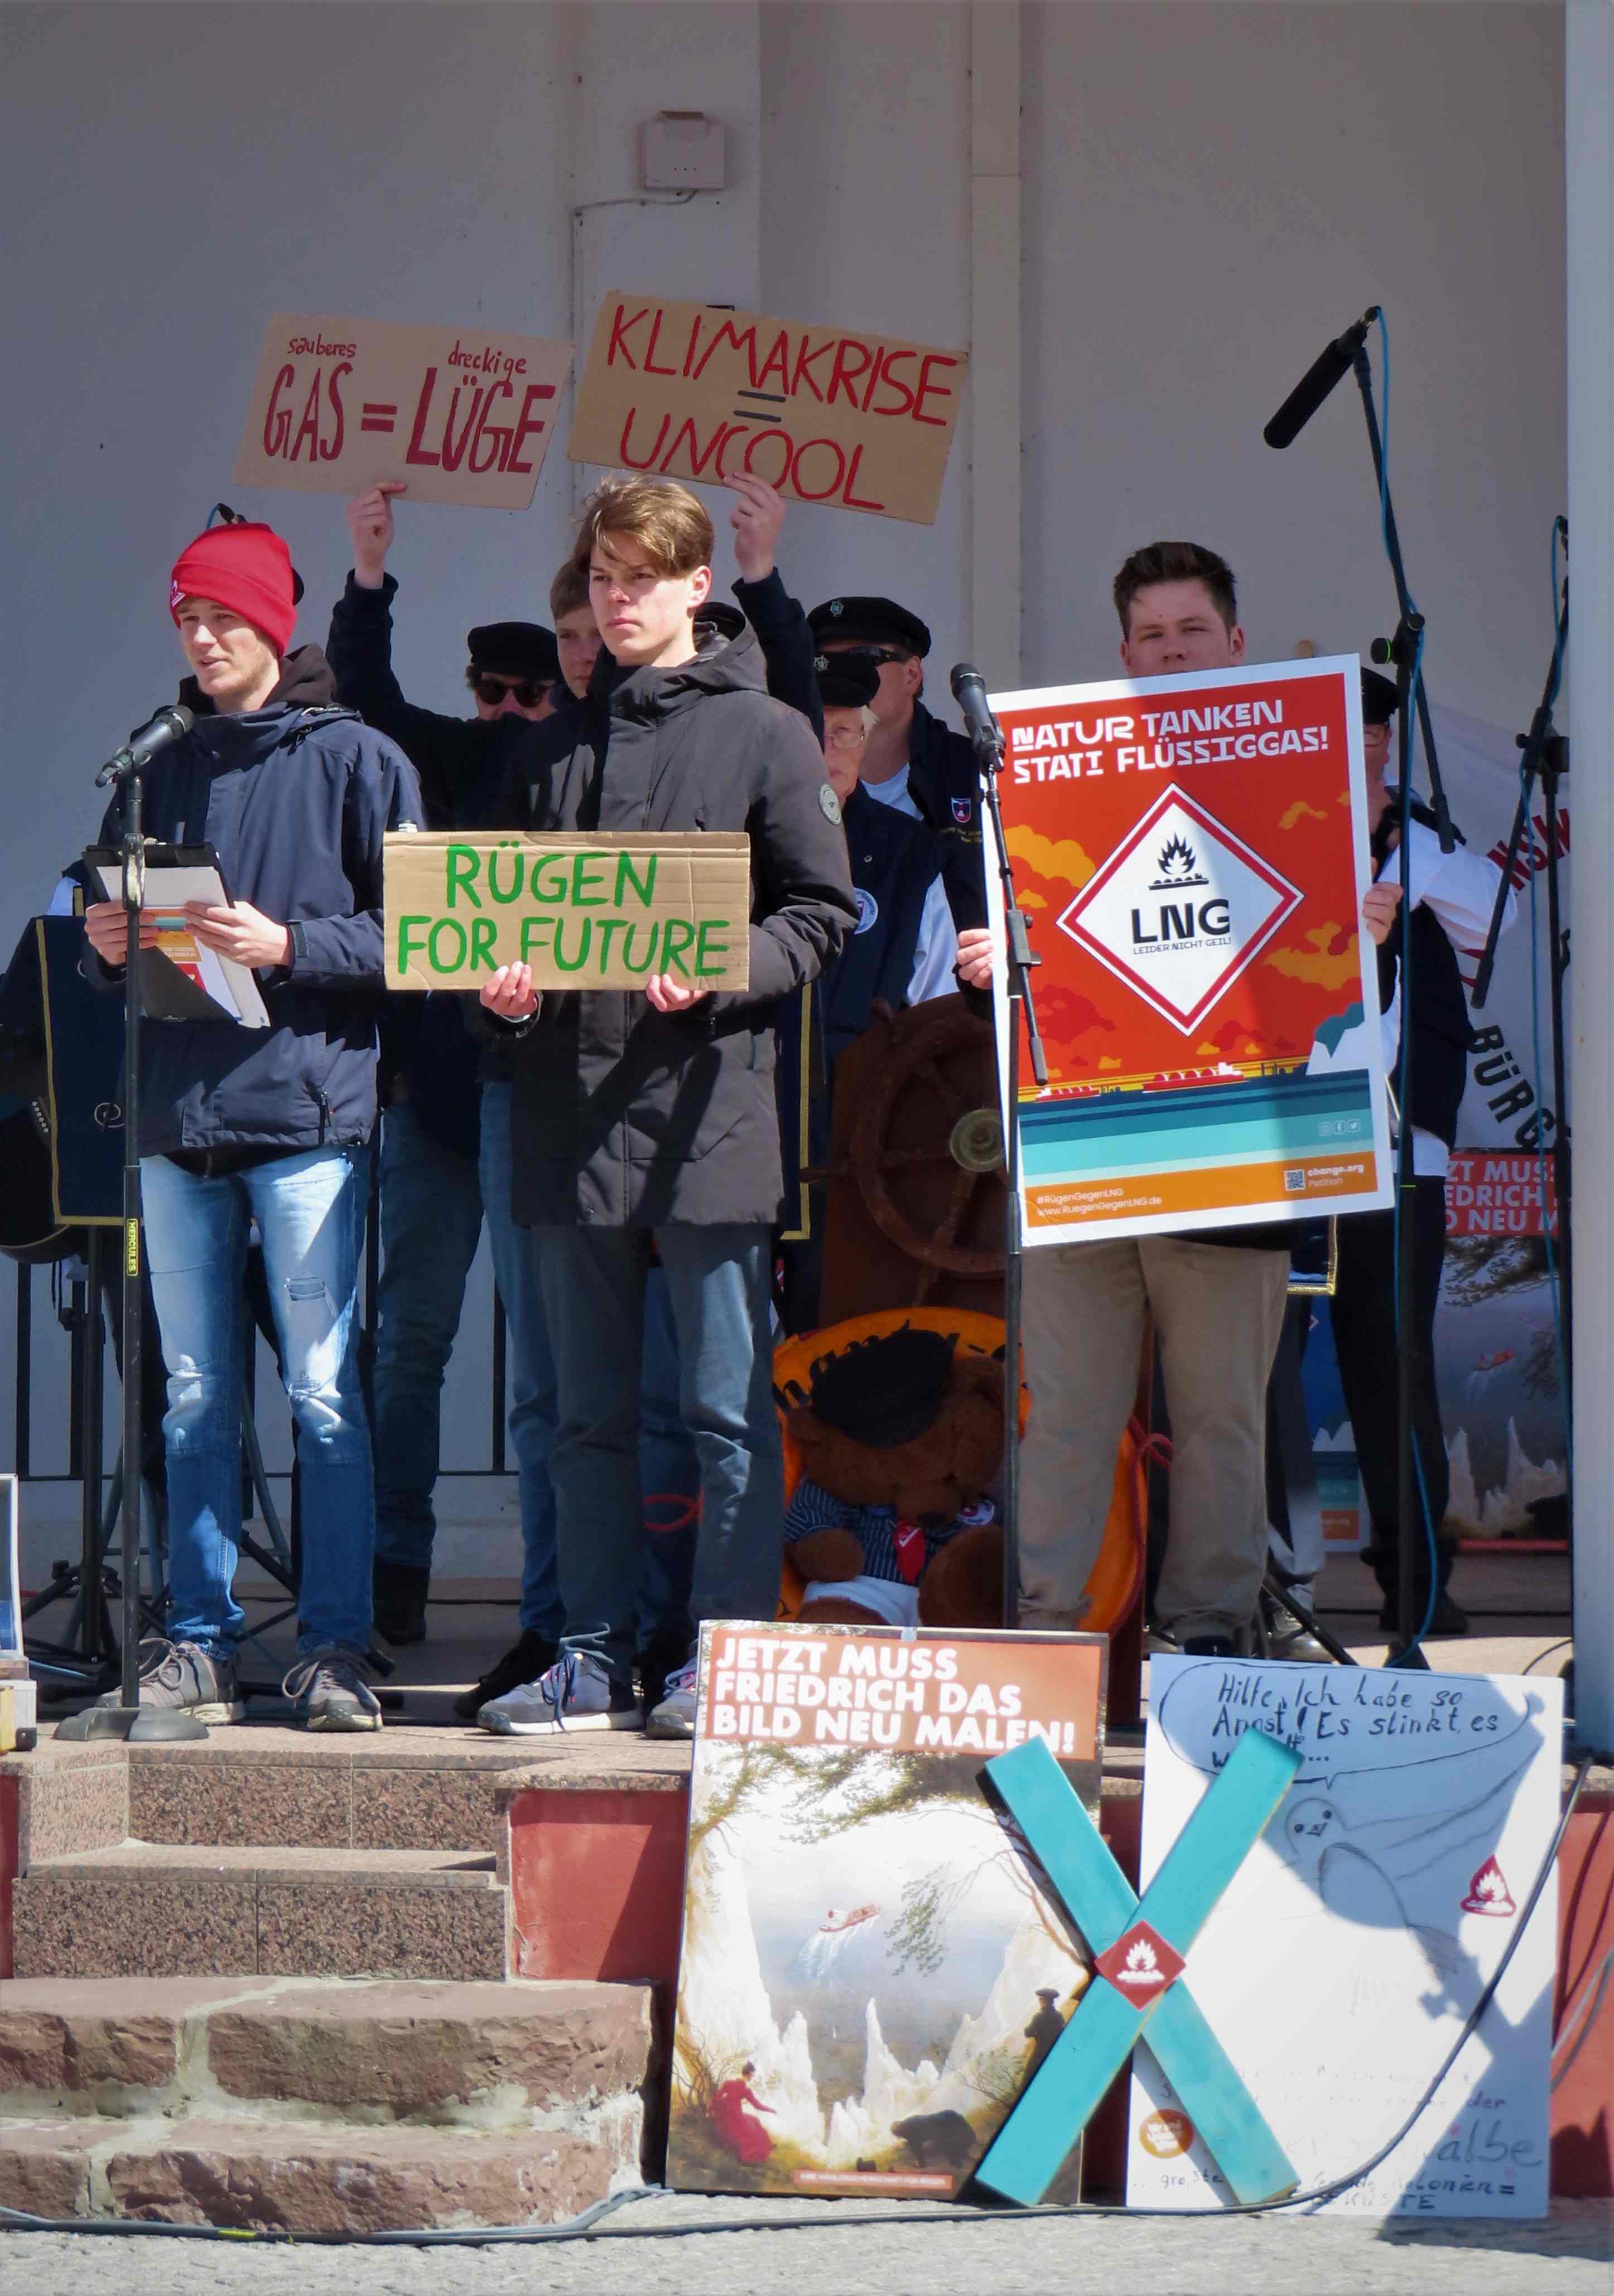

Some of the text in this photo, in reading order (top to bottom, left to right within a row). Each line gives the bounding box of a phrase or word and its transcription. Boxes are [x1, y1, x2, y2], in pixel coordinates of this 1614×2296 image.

[287, 334, 357, 358] sauberes
[447, 339, 527, 381] dreckige
[608, 304, 957, 426] KLIMAKRISE
[263, 363, 354, 462] GAS
[406, 366, 556, 474] LÜGE
[620, 407, 885, 511] UNCOOL
[1011, 698, 1283, 753] NATUR TANKEN
[1117, 726, 1328, 773] FLÜSSIGGAS!
[445, 840, 658, 908] RÜGEN
[1130, 898, 1231, 944] LNG
[397, 915, 730, 978] FOR FUTURE
[1133, 937, 1232, 955] LEIDER NICHT GEIL!
[1307, 1164, 1365, 1177] change.org
[1036, 1188, 1124, 1205] #RügenGegenLNG
[1037, 1196, 1163, 1217] www.RuegenGegenLNG.de
[1443, 1184, 1543, 1207] EDRICH
[1468, 1209, 1527, 1231] NEU
[716, 1637, 958, 1680] JETZT MUSS
[715, 1671, 1022, 1717] FRIEDRICH DAS
[1295, 1675, 1341, 1707] Ich
[1353, 1674, 1413, 1707] habe
[1430, 1690, 1464, 1706] so
[713, 1704, 1075, 1754] BILD NEU MALEN!
[1317, 1710, 1351, 1739] Es
[1470, 1714, 1499, 1731] es
